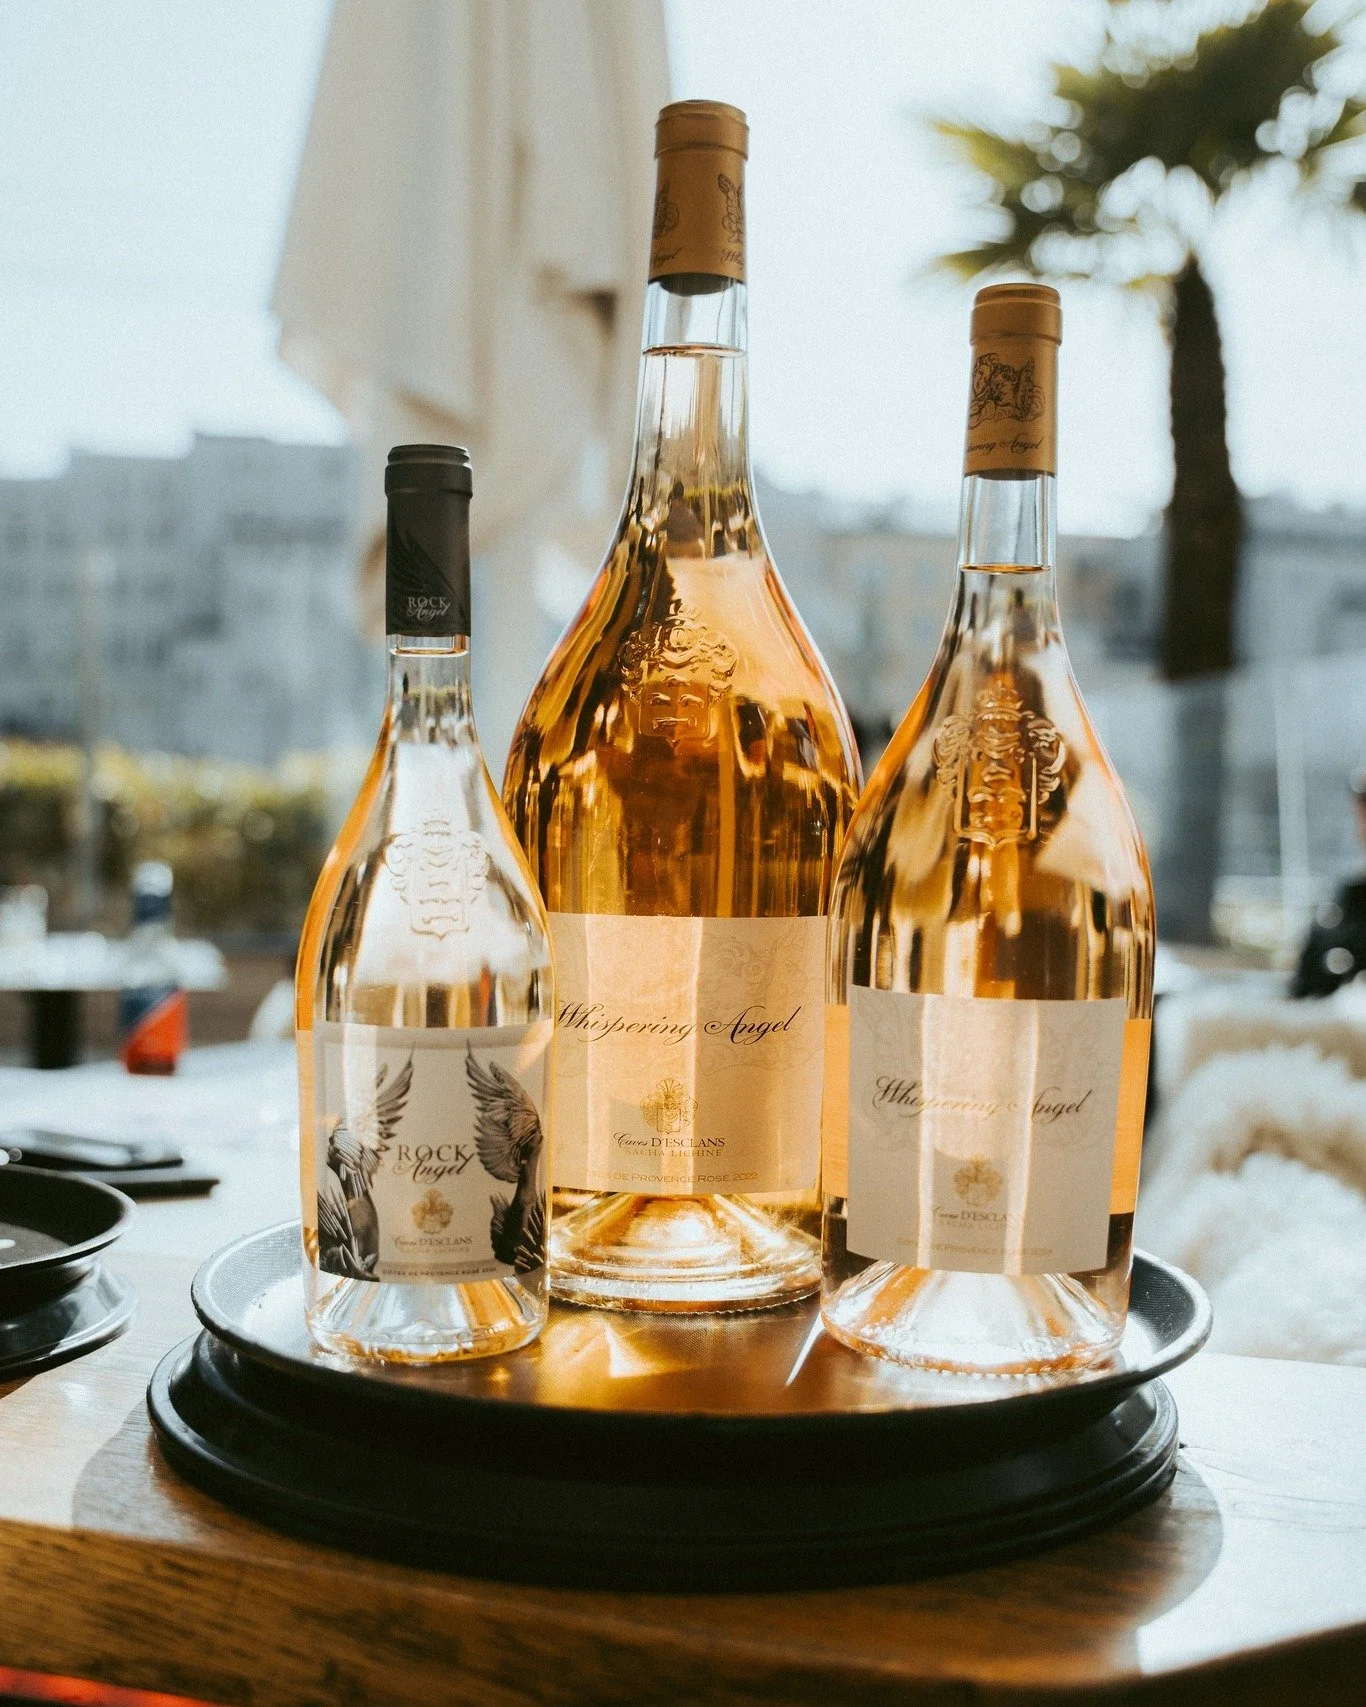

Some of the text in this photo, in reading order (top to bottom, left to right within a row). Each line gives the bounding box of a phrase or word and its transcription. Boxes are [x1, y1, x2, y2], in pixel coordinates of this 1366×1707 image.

[999, 432, 1044, 454] Angel
[407, 602, 451, 621] Angel
[408, 596, 447, 608] ROCK
[558, 1000, 801, 1045] Whispering Angel
[1007, 1086, 1092, 1125] Angel
[613, 1132, 725, 1148] Caves D'ESCLANS
[398, 1144, 468, 1161] ROCK
[626, 1148, 722, 1157] SACHA LICHINE
[393, 1152, 475, 1184] Angel
